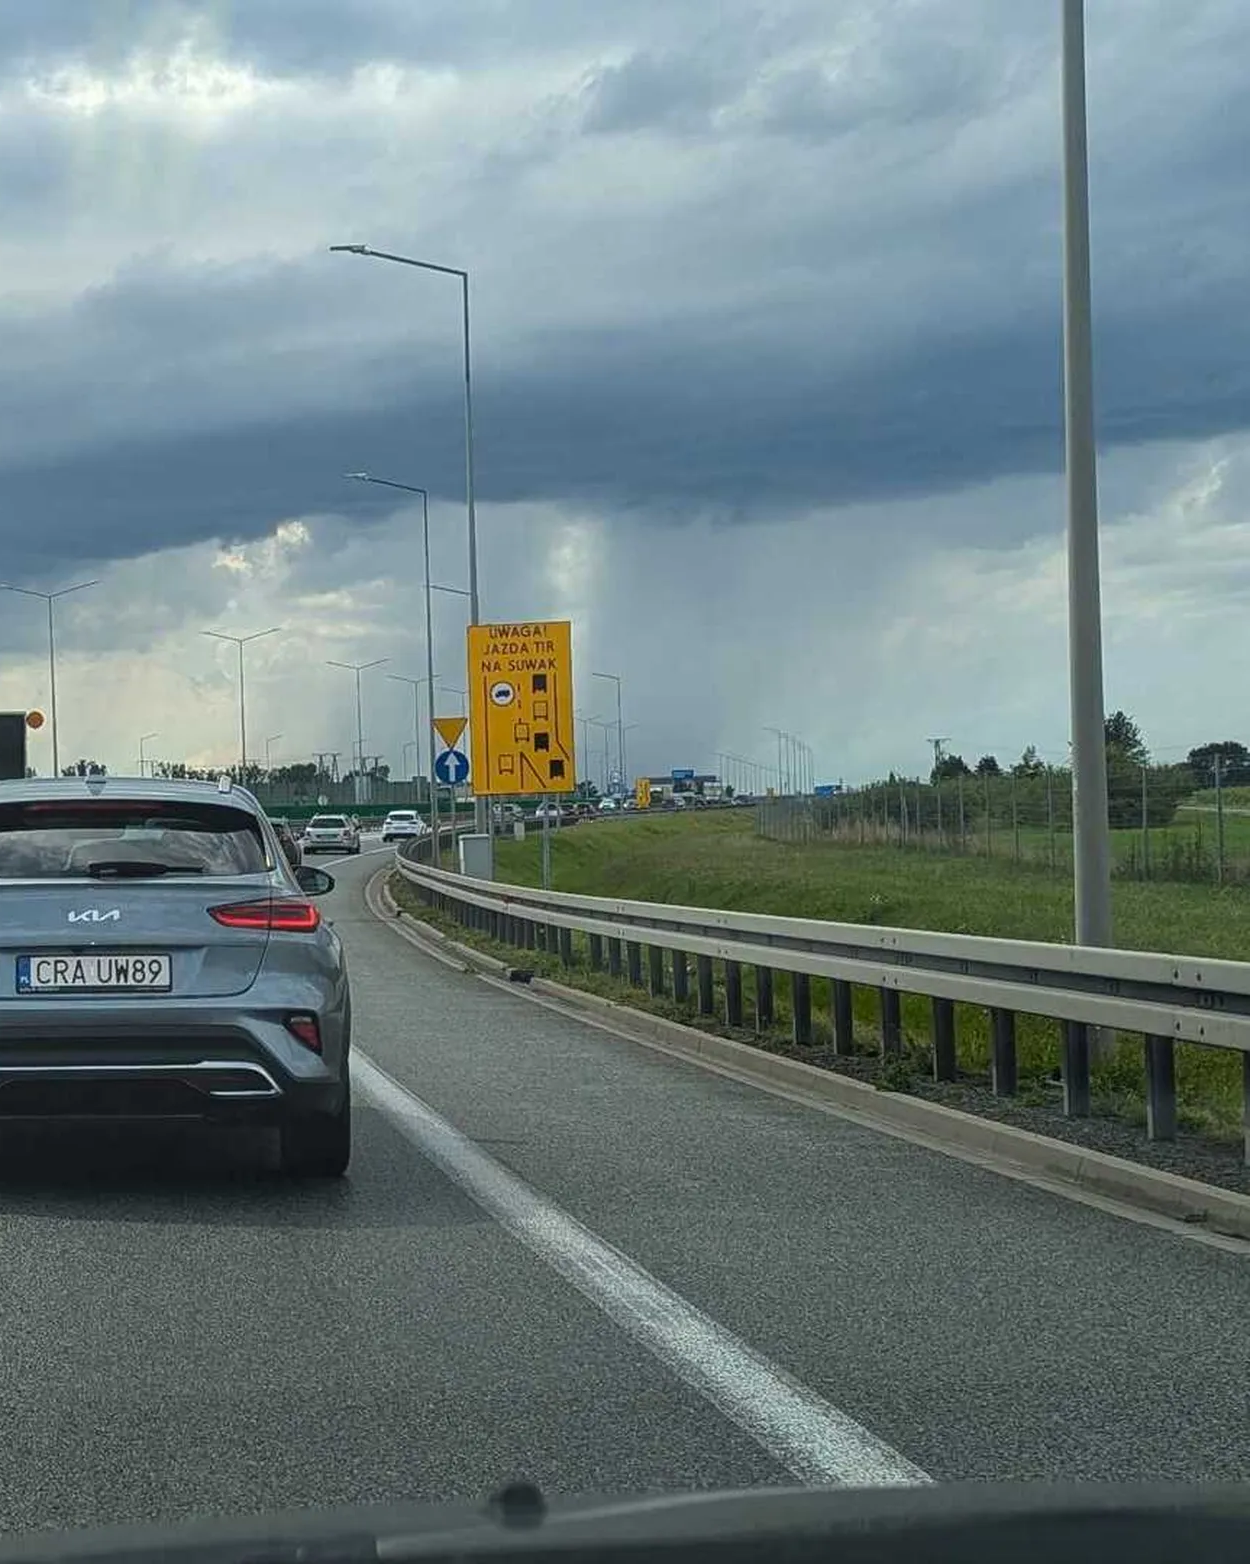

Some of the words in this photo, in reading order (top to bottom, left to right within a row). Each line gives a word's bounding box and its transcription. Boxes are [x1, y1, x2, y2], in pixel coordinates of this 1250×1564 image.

[489, 626, 547, 638] UWAGA!
[483, 642, 529, 655] JAZDA
[533, 641, 554, 653] TIR
[481, 661, 502, 672] NA
[508, 658, 556, 671] SUWAK
[68, 909, 120, 923] KIA
[36, 959, 86, 985] CRA
[96, 959, 162, 985] UW89
